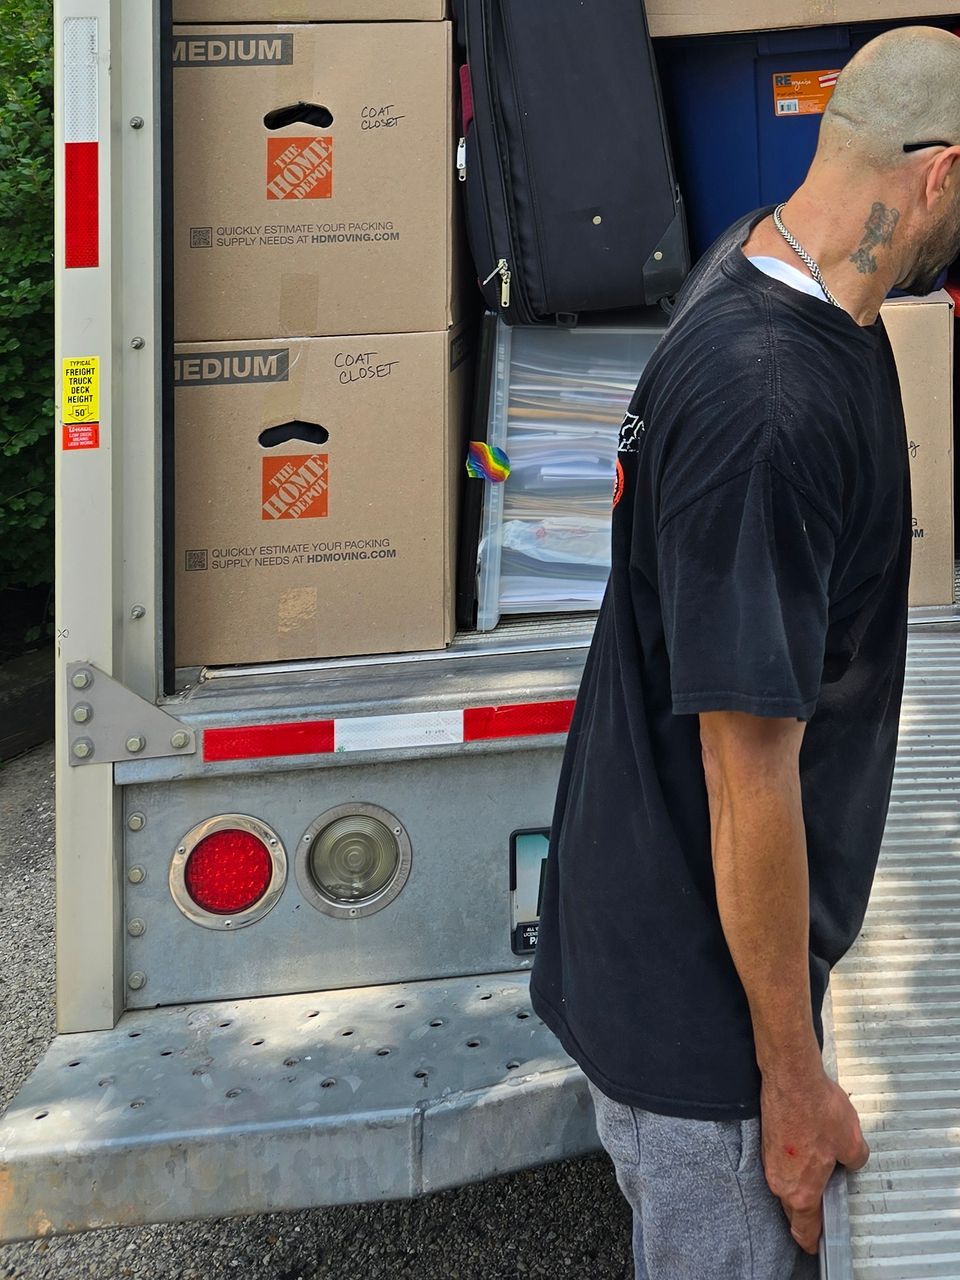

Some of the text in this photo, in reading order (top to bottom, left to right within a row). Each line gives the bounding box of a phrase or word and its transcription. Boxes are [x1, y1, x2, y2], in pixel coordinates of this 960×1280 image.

[172, 39, 282, 61] MEDIUM
[361, 105, 395, 119] COAT
[361, 115, 405, 131] CLOSET
[273, 143, 301, 169] THE
[266, 136, 333, 201] HOME
[291, 160, 333, 200] DEPOT
[216, 221, 394, 236] QUICKLY ESTIMATE YOUR PACKING
[216, 232, 400, 247] SUPPLY NEEDS AT HDMOVING.COM
[334, 352, 378, 368] COAT
[66, 368, 95, 376] FREIGHT
[69, 377, 92, 385] TRUCK
[339, 361, 400, 385] CLOSET
[68, 395, 93, 403] HEIGHT
[71, 386, 90, 394] DECK
[268, 462, 297, 489] THE
[262, 454, 329, 520] HOME
[287, 476, 329, 520] DEPOT
[211, 538, 390, 558] QUICKLY ESTIMATE YOUR PACKING
[211, 549, 397, 570] SUPPLY NEEDS AT HDMOVING.COM
